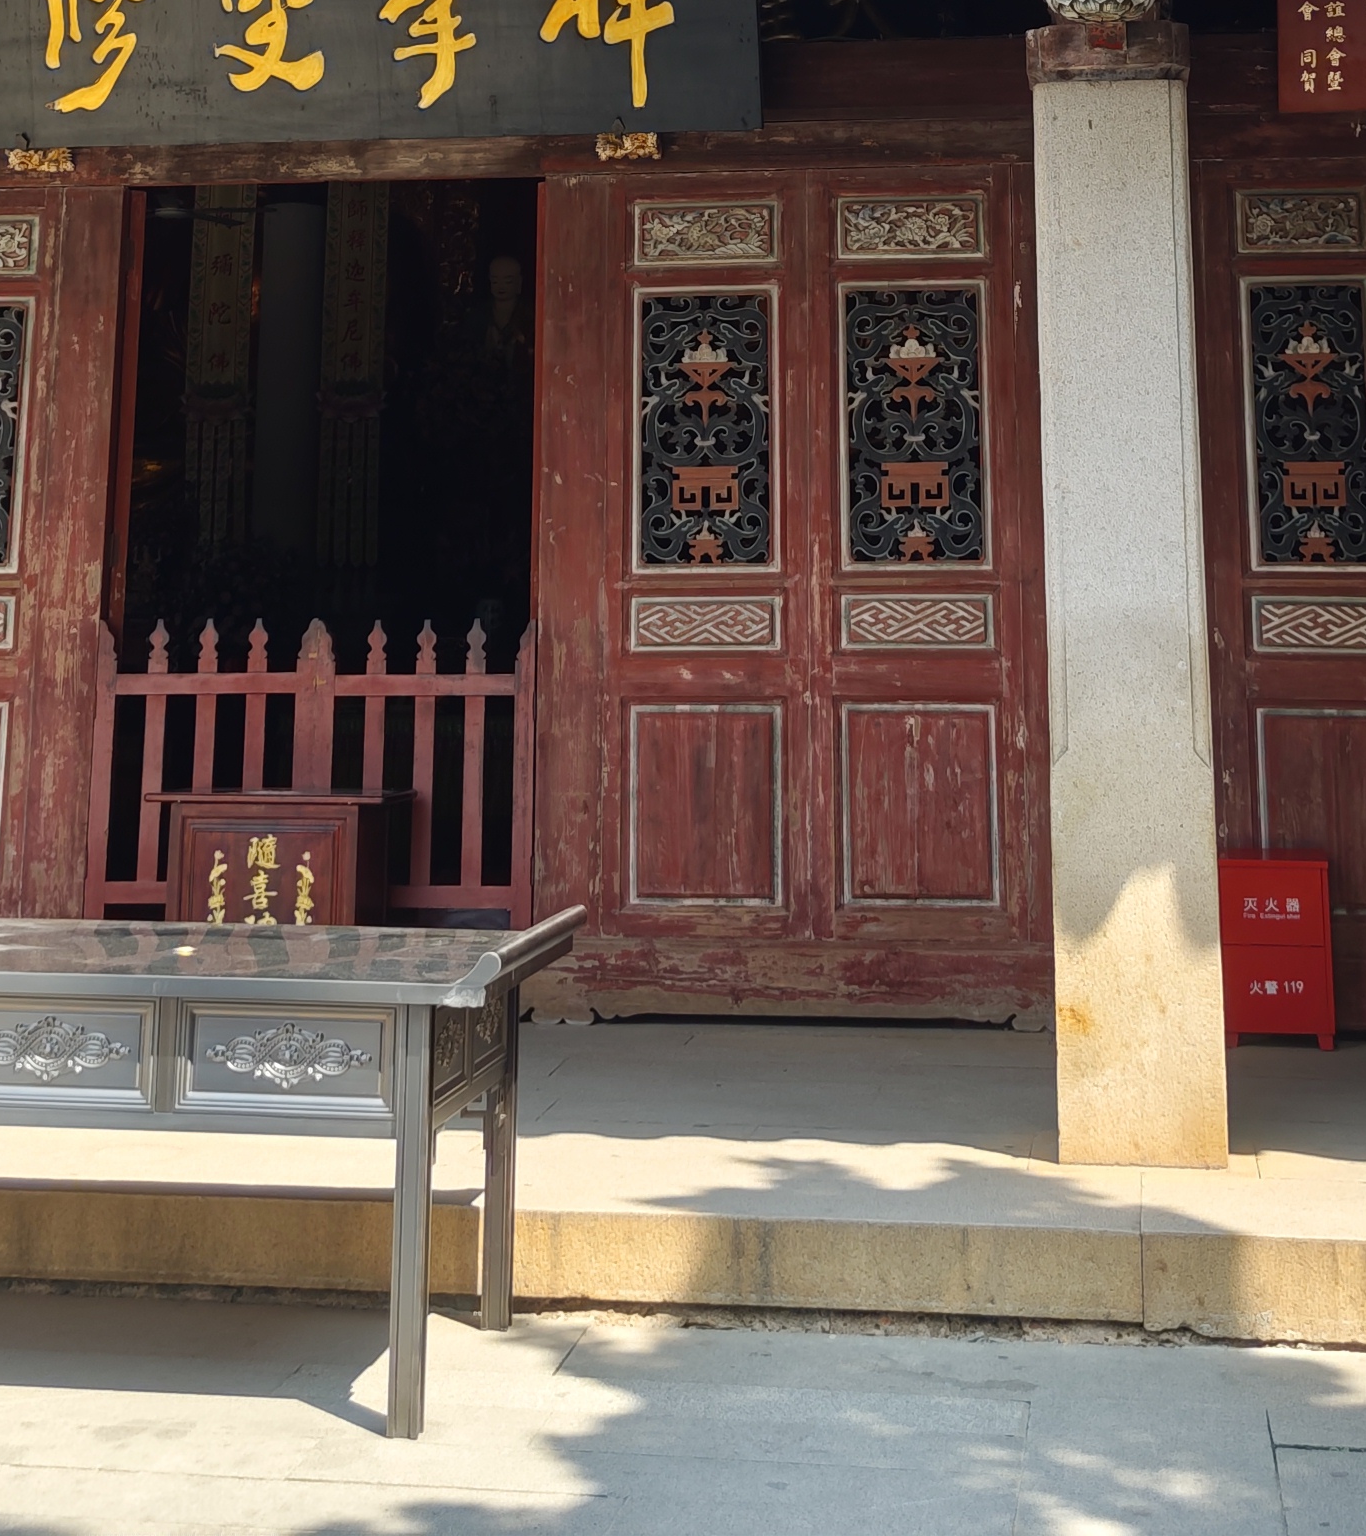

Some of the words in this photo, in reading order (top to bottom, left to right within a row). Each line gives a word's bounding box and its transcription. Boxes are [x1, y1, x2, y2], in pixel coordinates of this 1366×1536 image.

[1243, 897, 1300, 913] 灭火器
[1250, 980, 1279, 995] 火警
[1284, 980, 1304, 994] 119
